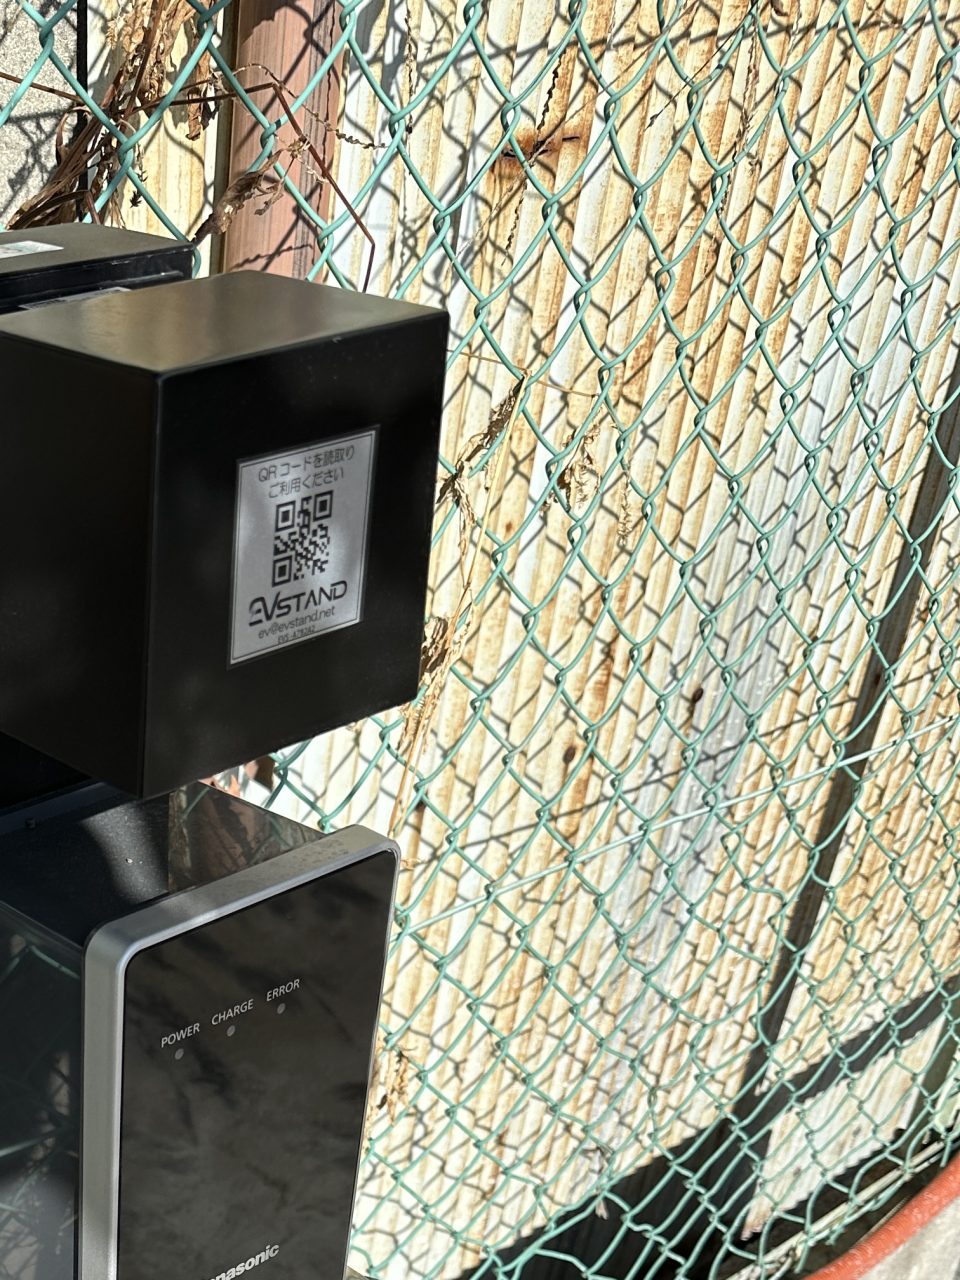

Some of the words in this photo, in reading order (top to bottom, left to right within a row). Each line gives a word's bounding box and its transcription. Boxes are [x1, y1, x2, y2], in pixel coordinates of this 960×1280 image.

[268, 467, 344, 498] ご利用ください
[248, 580, 347, 627] EVSTAND
[258, 605, 335, 639] ev@evstand.net
[161, 1022, 200, 1048] POWER
[211, 998, 254, 1025] CHARGE
[266, 978, 300, 1002] ERROR
